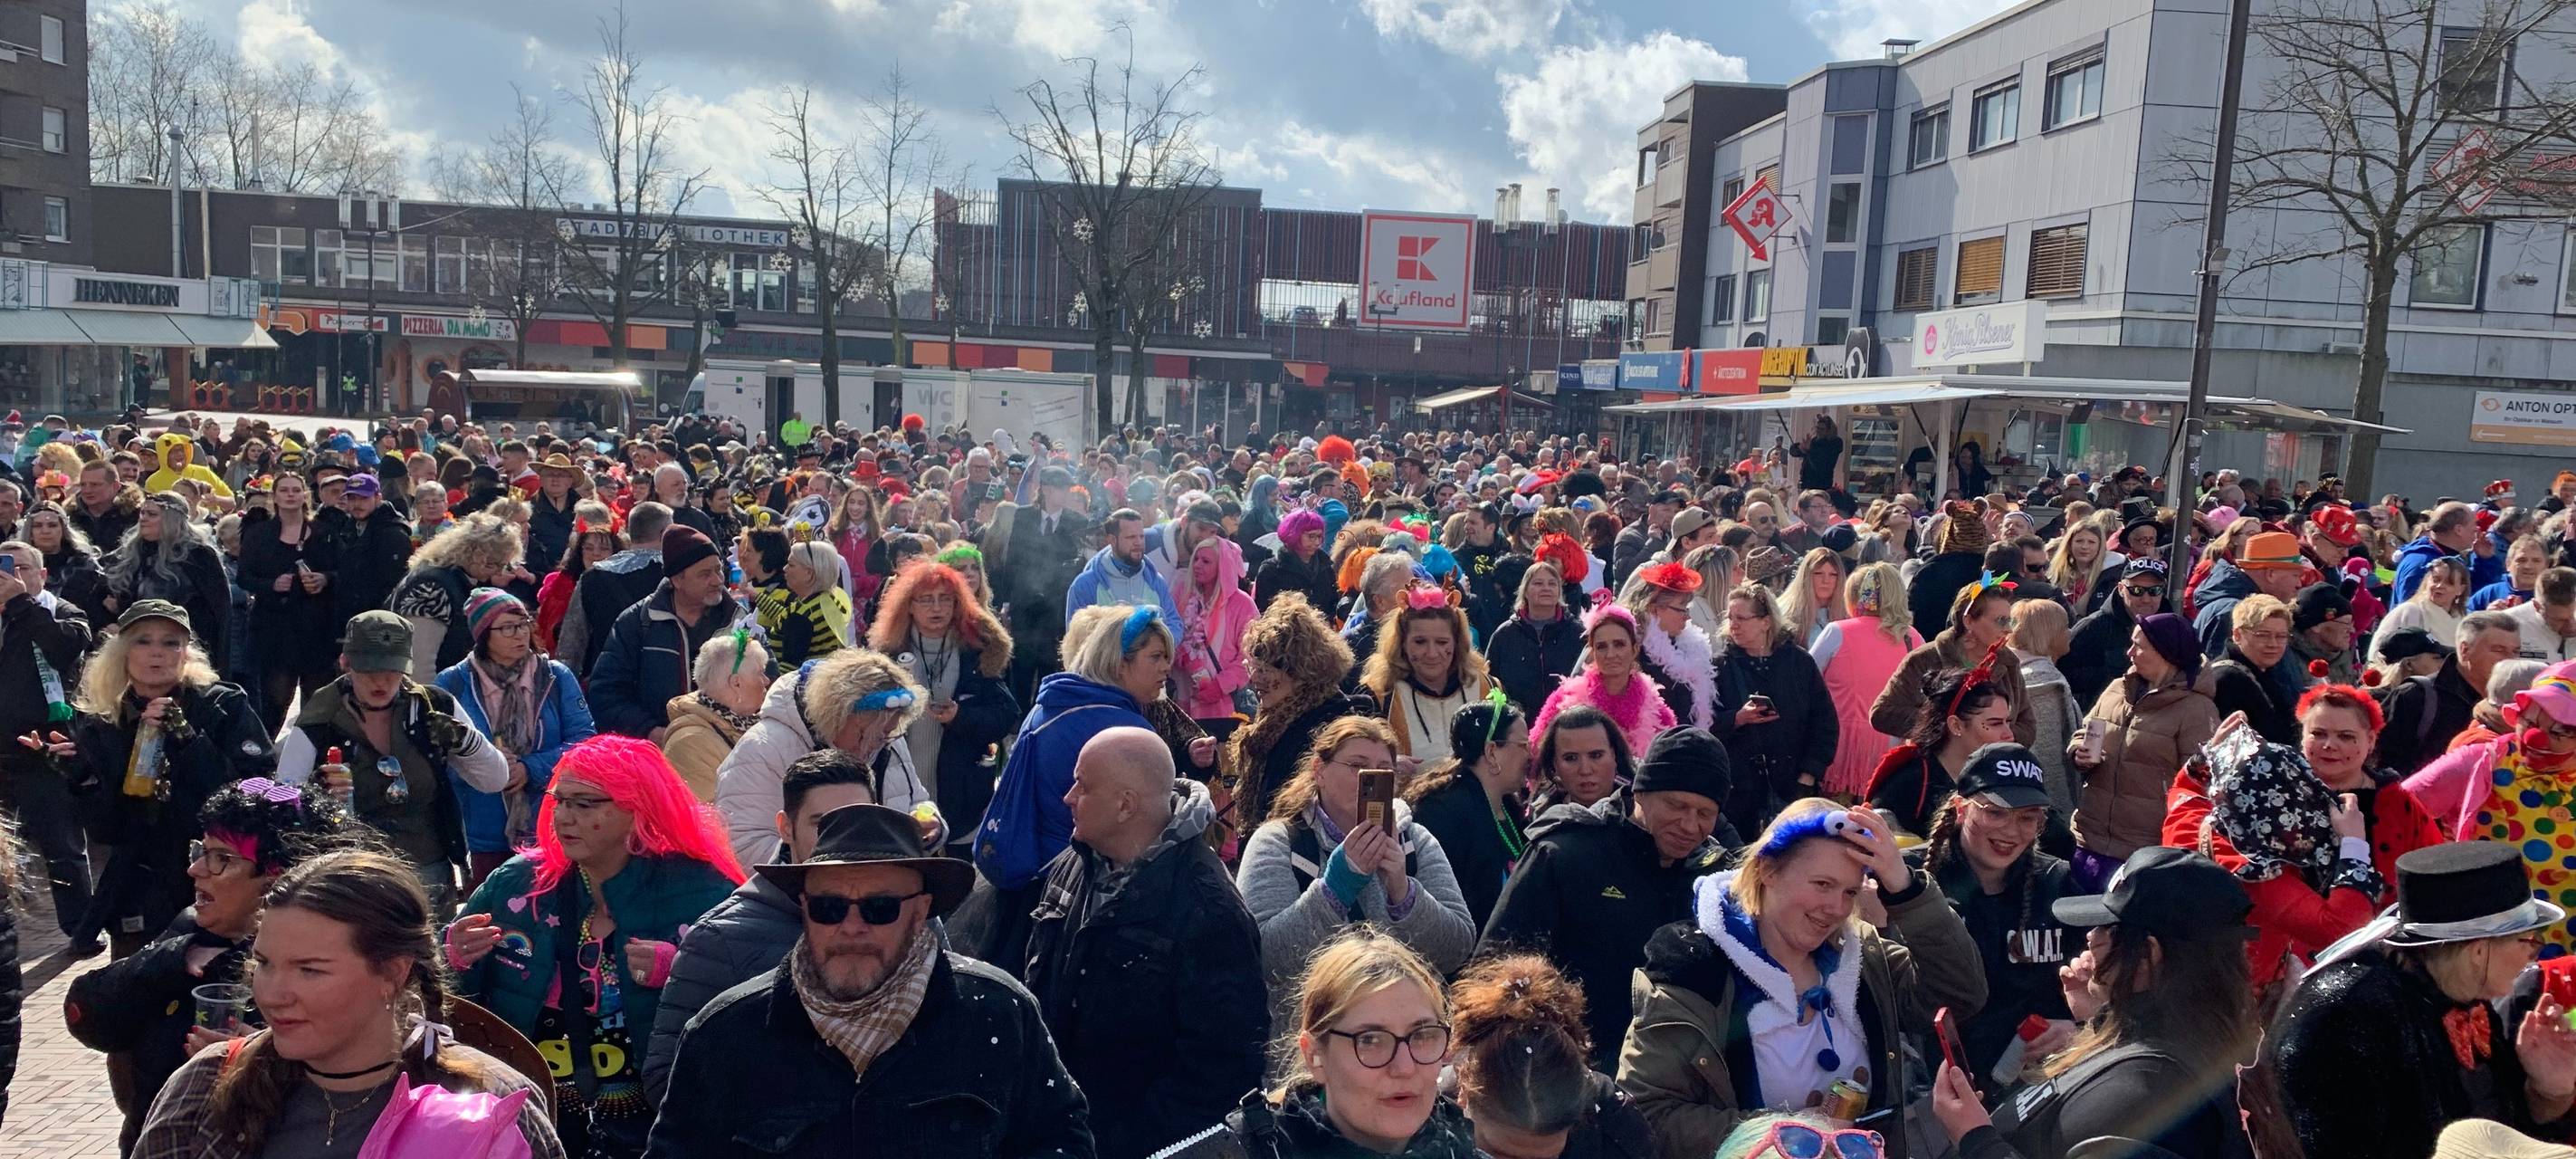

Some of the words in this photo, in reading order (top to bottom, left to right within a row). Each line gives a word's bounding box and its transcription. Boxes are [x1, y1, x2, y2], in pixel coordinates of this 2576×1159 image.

[558, 220, 785, 244] STADTBILIOTHEK
[75, 278, 180, 307] HENNEKEN
[1375, 290, 1456, 308] Kaufland
[402, 317, 444, 335] PIZZERIA
[447, 321, 462, 336] DA
[463, 322, 491, 338] MIMO
[1973, 312, 2016, 345] Pilsener
[917, 389, 952, 406] WC
[2505, 401, 2550, 413] ANTON
[2553, 403, 2576, 414] OPT
[2130, 560, 2164, 574] POLICE
[1996, 760, 2044, 783] SWAT
